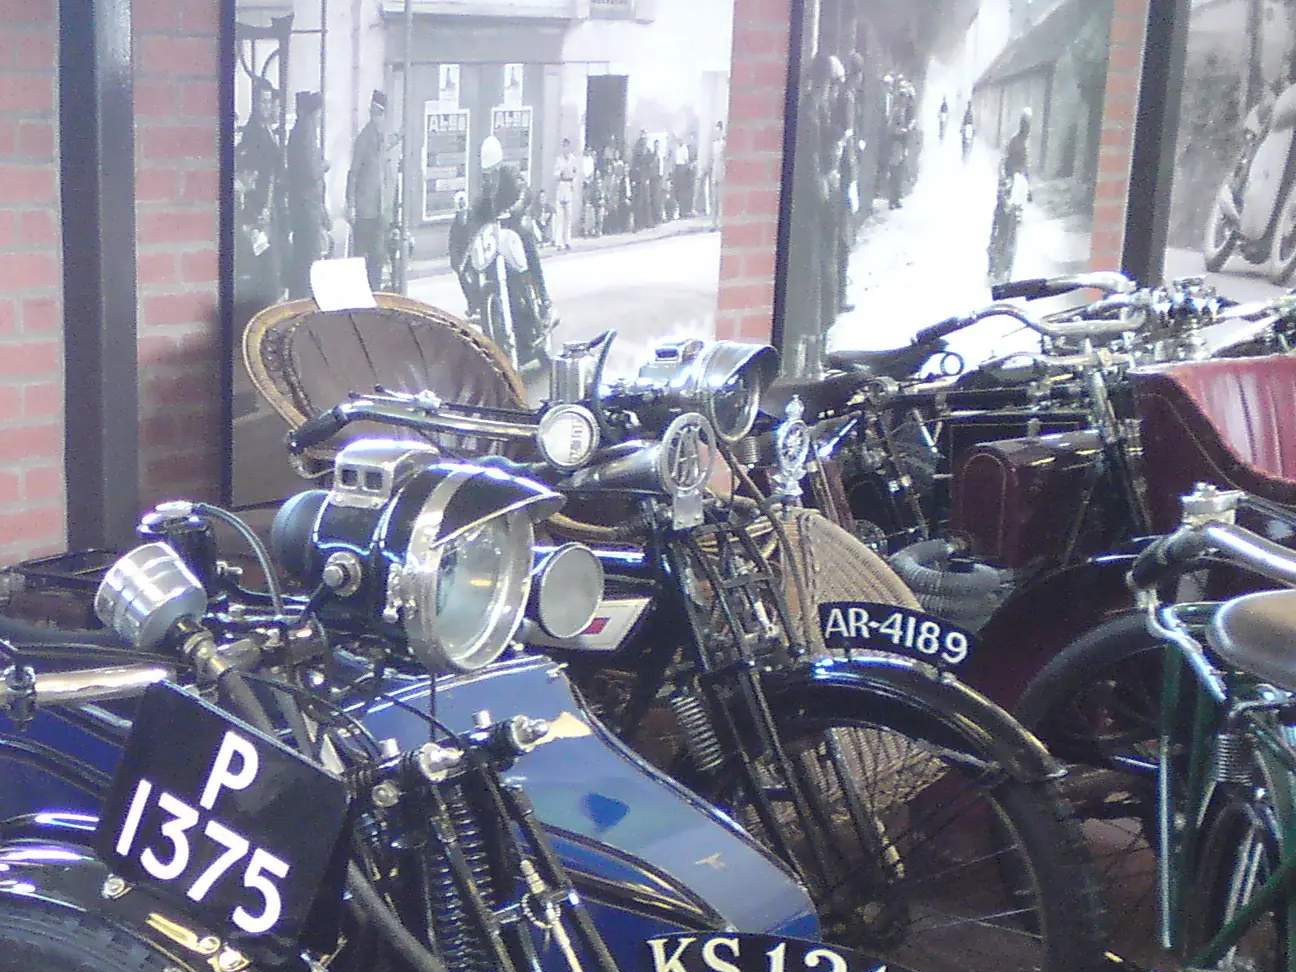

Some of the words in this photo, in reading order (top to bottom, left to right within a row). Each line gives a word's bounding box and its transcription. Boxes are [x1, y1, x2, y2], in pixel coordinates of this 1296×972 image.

[825, 607, 968, 664] AR-4189
[200, 730, 259, 810] P
[116, 778, 290, 933] 1375
